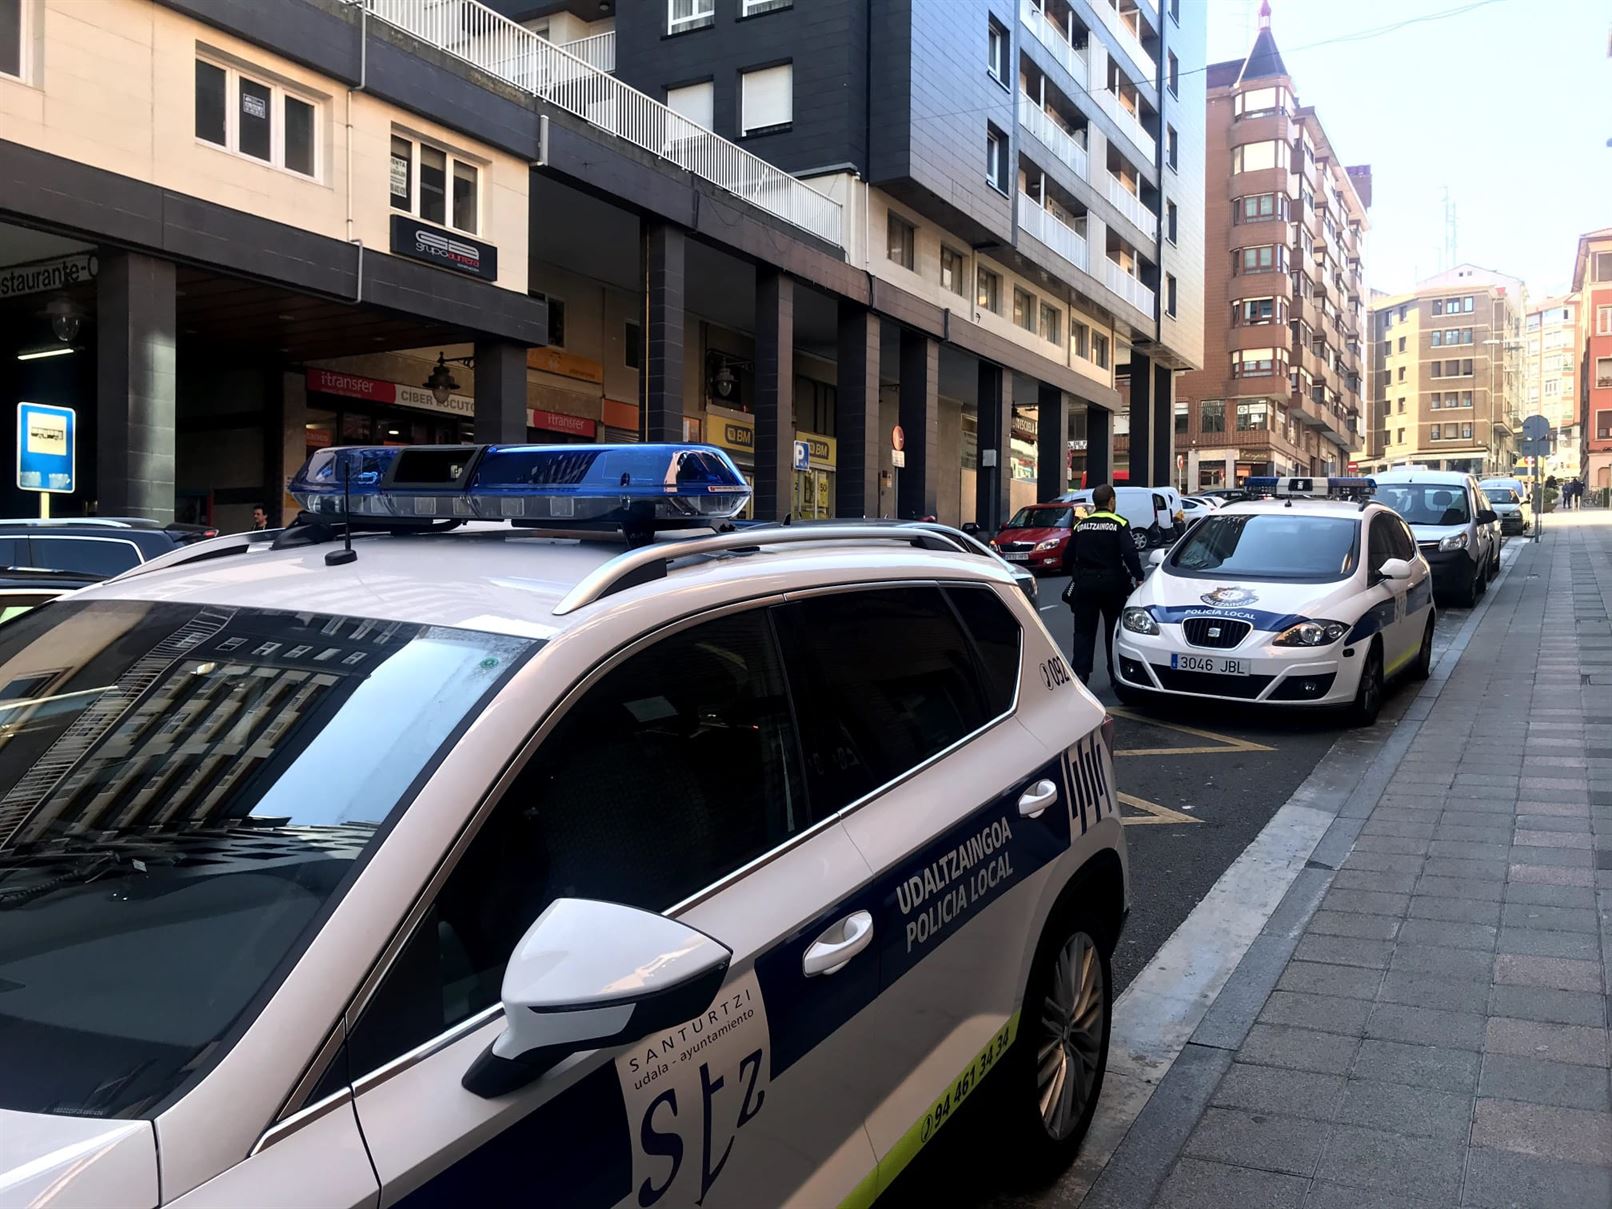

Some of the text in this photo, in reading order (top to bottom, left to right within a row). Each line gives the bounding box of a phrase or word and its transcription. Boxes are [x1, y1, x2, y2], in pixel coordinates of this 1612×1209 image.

[401, 390, 433, 405] CIBER
[736, 429, 751, 444] BM
[796, 445, 805, 465] P
[816, 444, 828, 456] BM
[1224, 609, 1256, 620] LOCAL
[1048, 655, 1070, 687] 092
[1180, 656, 1245, 674] 3046 JBL
[896, 816, 1012, 915] UDALTZAINGOA
[906, 851, 1014, 953] POLICIA LOCAL
[629, 989, 751, 1072] SANTURTZI
[634, 1062, 669, 1090] udala
[680, 1008, 754, 1062] ayuntamiento
[935, 1024, 1009, 1129] 94 461 34 34
